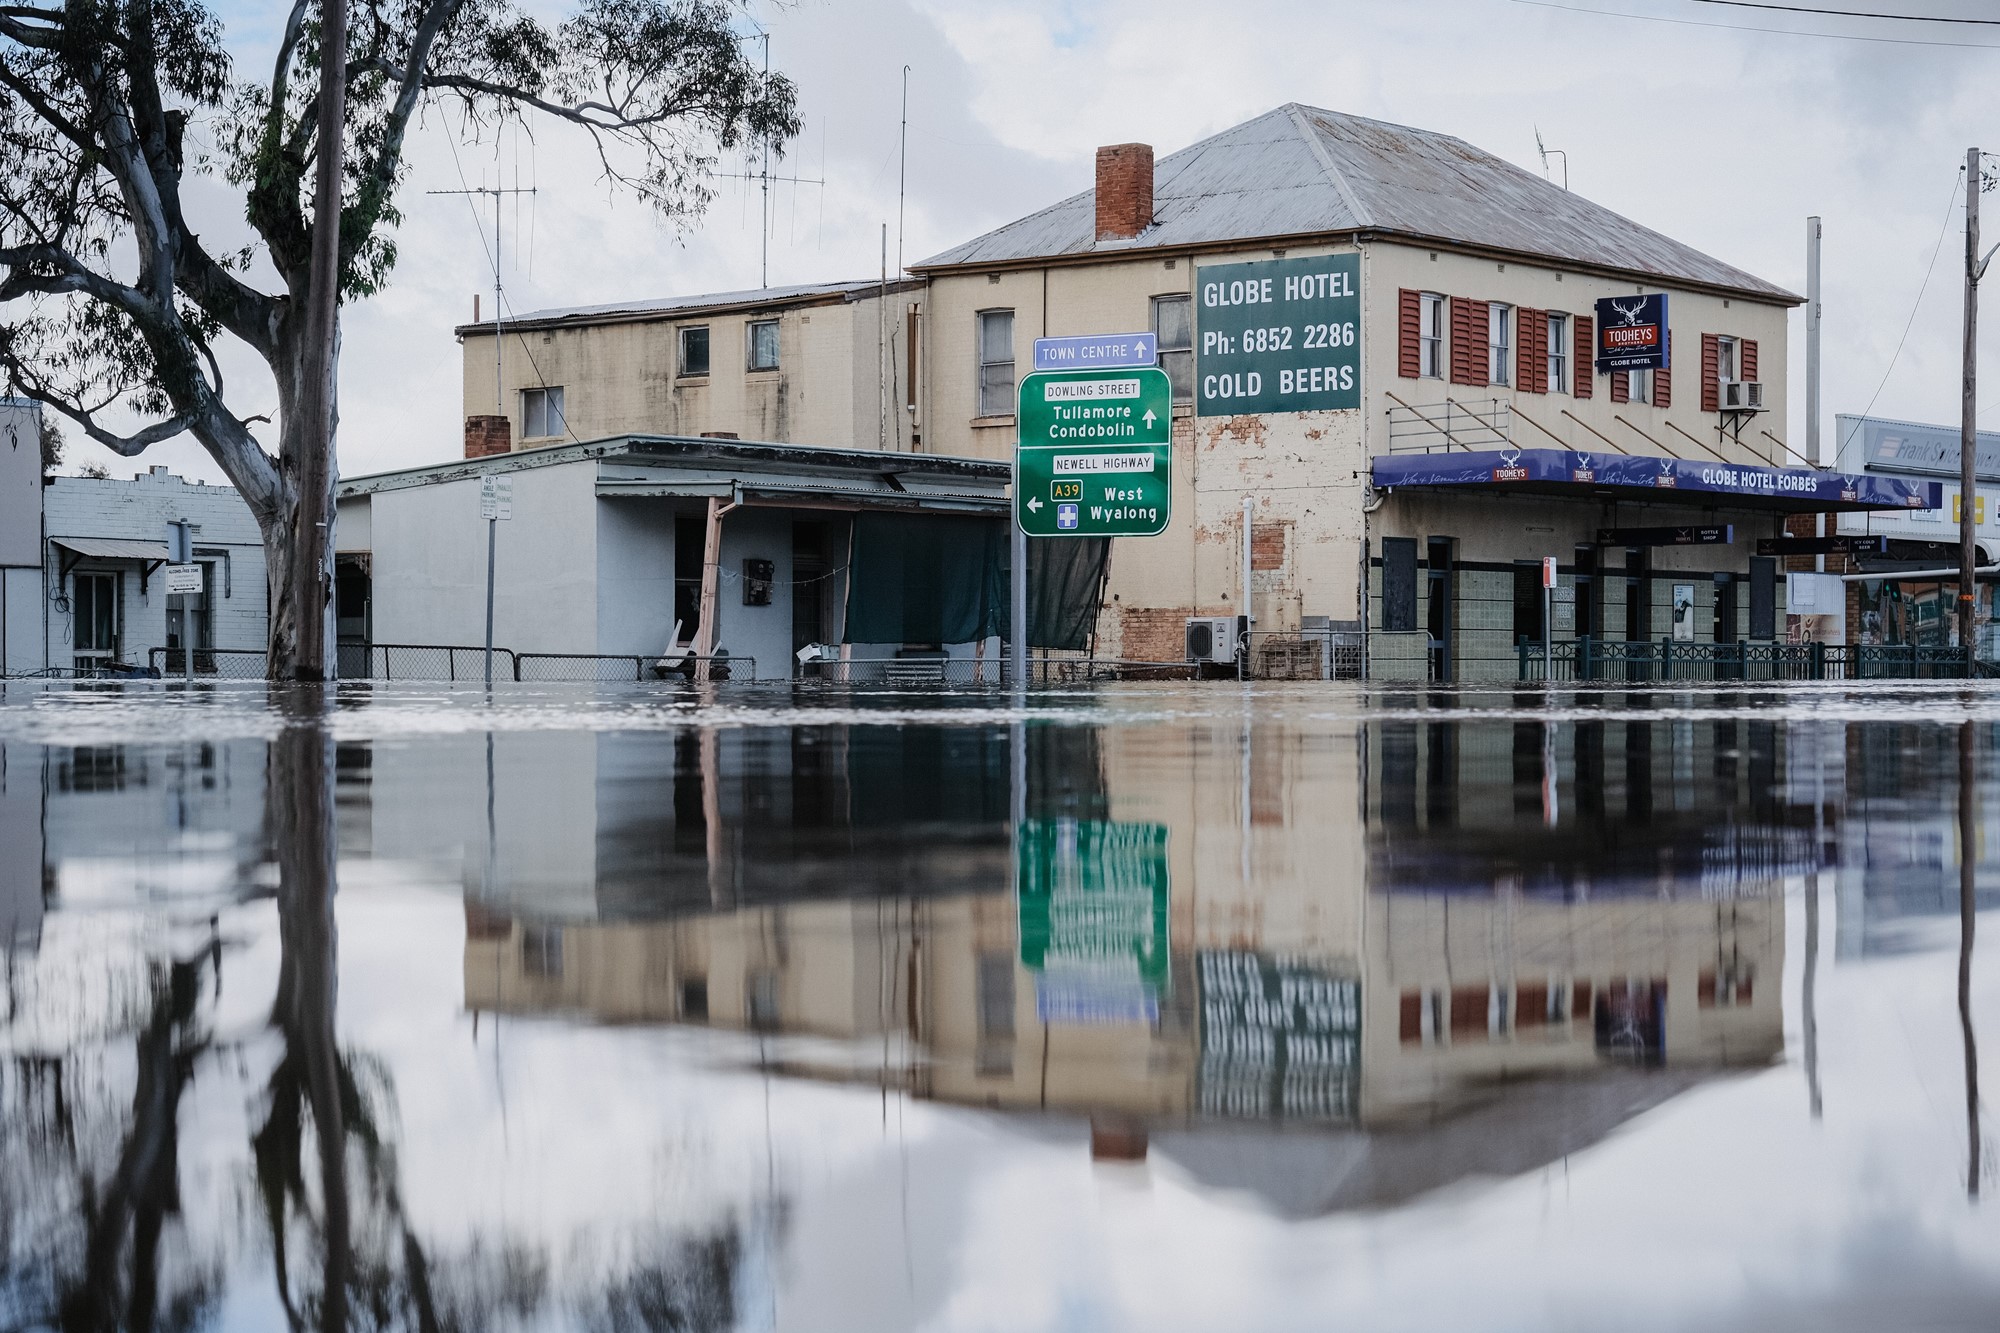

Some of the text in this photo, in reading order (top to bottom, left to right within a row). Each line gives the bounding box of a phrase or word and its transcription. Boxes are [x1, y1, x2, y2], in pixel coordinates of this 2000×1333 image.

[1203, 272, 1354, 307] GLOBE HOTEL
[1203, 322, 1355, 356] Ph: 6852 2286
[1609, 328, 1652, 342] TOOHEYS
[1043, 344, 1128, 360] TOWN CENTRE
[1203, 365, 1354, 400] COLD BEERS
[1048, 383, 1137, 397] DOWLING STREET
[1053, 406, 1131, 420] Tullamore
[1049, 424, 1135, 439] Condobolin
[1896, 438, 1930, 462] Frank
[1056, 457, 1150, 470] NEWELL HIGHWAY
[1496, 469, 1525, 478] TOOHEYS
[1575, 470, 1593, 479] TOOHEYS
[1702, 468, 1817, 492] GLOBE HOTEL FORBES
[1055, 485, 1079, 497] A39
[1104, 487, 1143, 501] West
[1090, 506, 1157, 523] Wyalong
